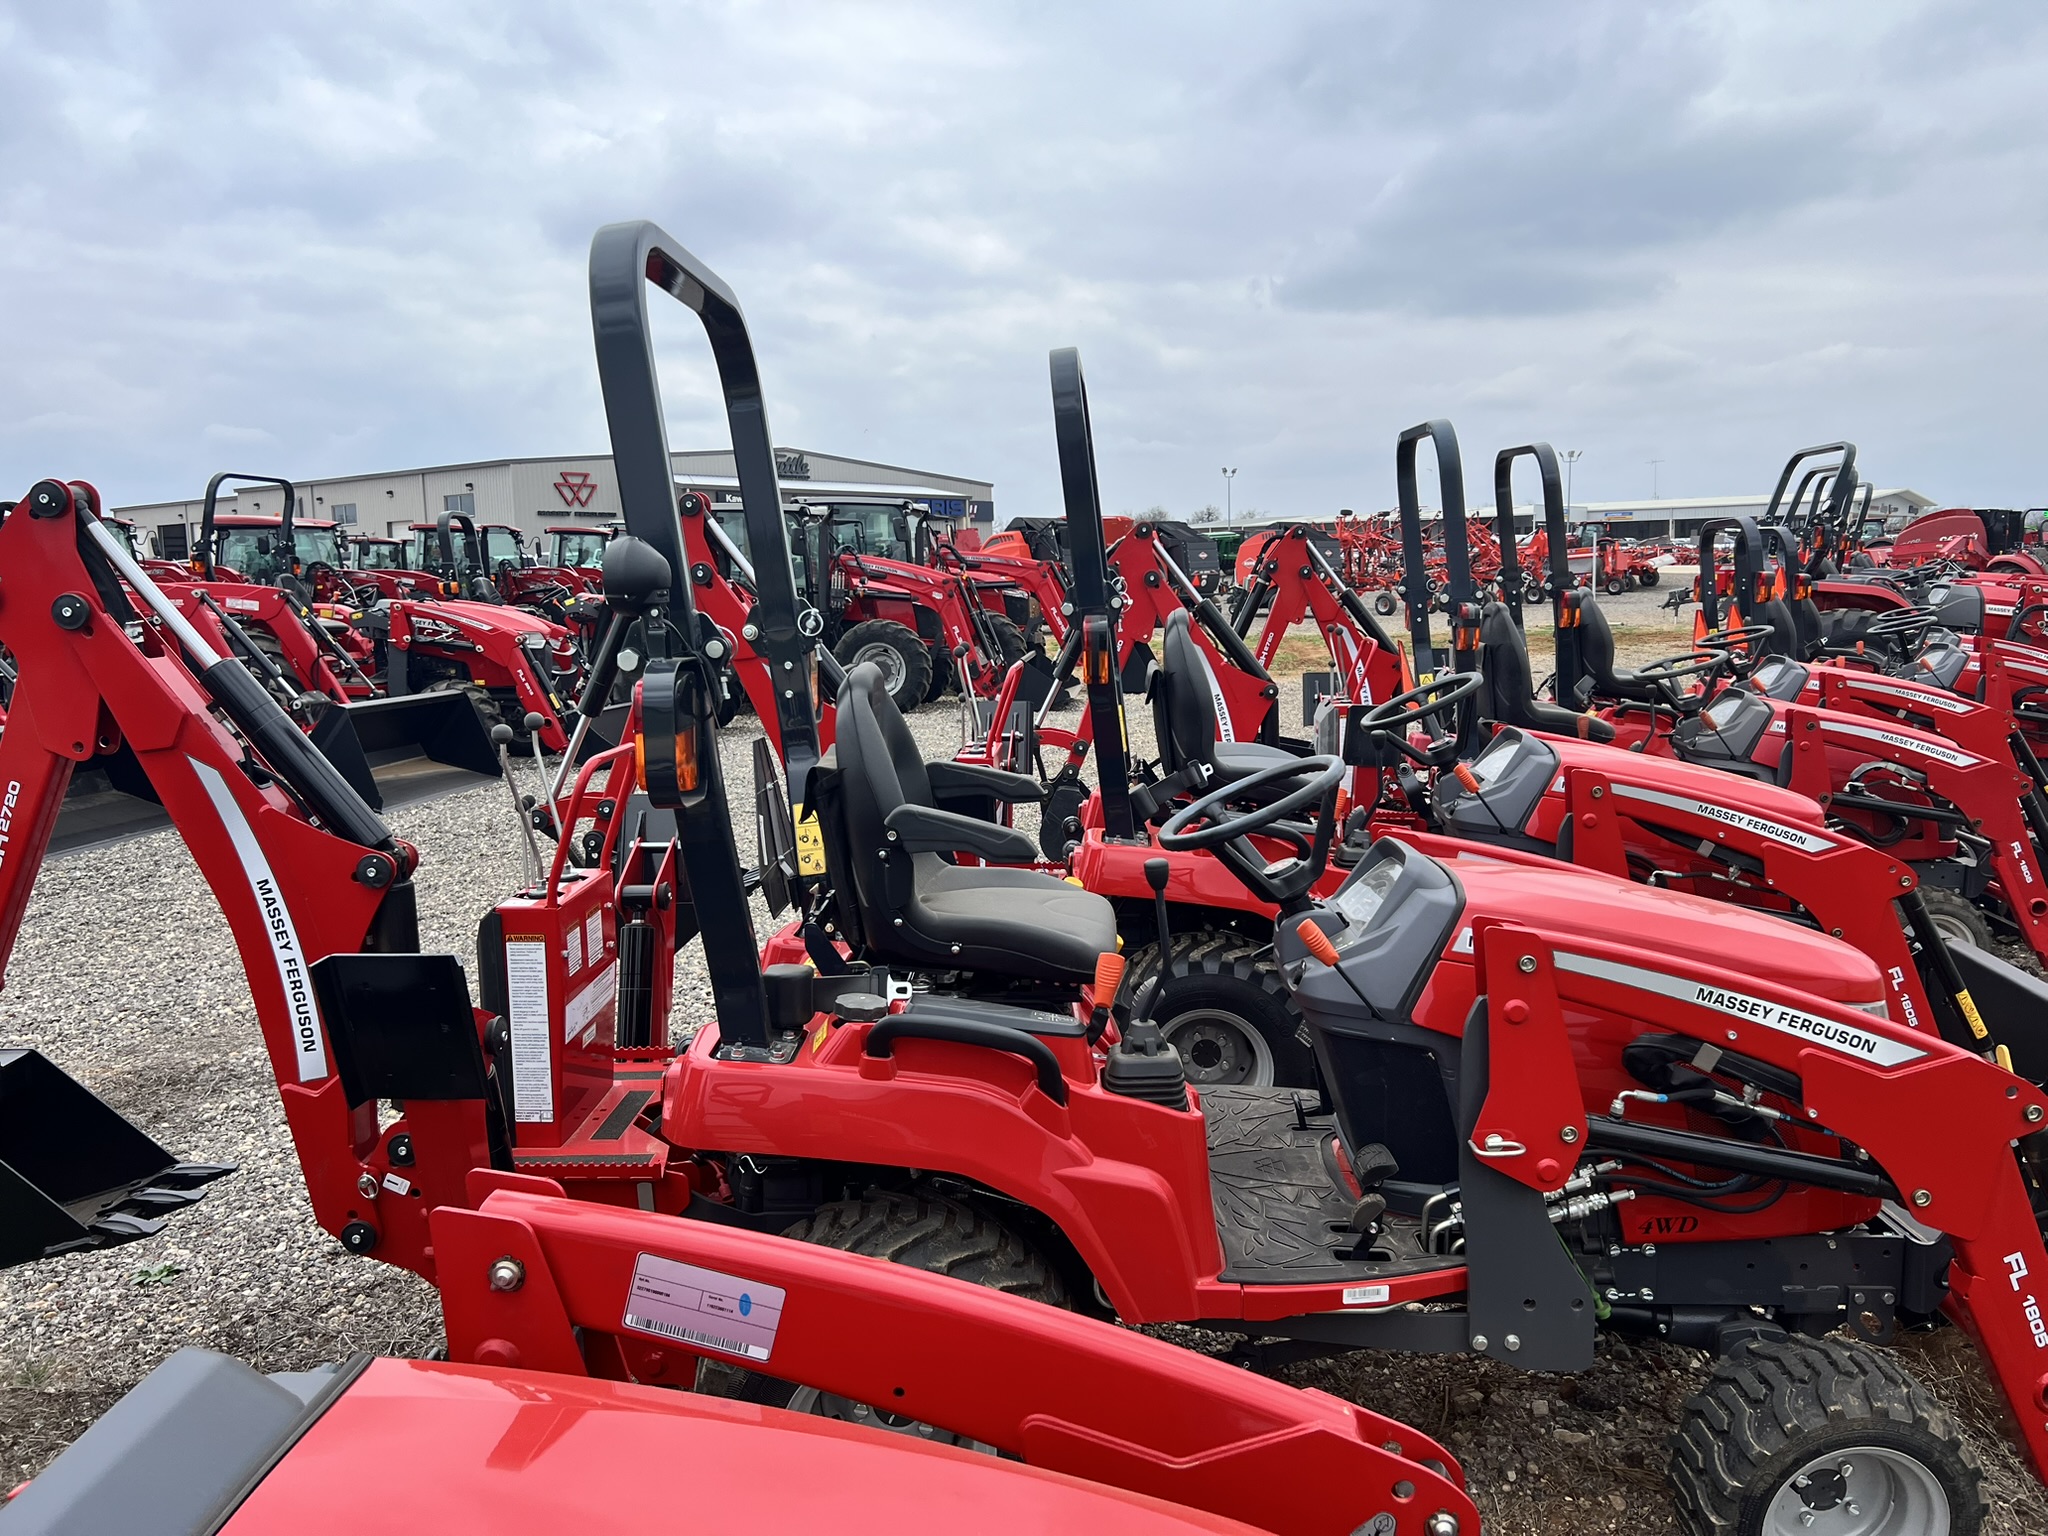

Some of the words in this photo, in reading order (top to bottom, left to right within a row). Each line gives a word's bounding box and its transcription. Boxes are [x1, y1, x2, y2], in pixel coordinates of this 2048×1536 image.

[1214, 693, 1229, 726] MASSEY
[1894, 689, 1922, 699] MASSEY
[1923, 695, 1958, 709] FERGUSON
[1880, 733, 1915, 747] MASSEY
[1915, 743, 1958, 761] FERGUSON
[0, 780, 21, 833] 2720
[1697, 804, 1745, 824] MASSEY
[1746, 818, 1807, 845] FERGUSON
[2010, 841, 2022, 858] FL
[256, 878, 293, 951] MASSEY
[283, 957, 317, 1053] FERGUSON
[1887, 966, 1904, 991] FL
[1900, 993, 1918, 1027] 1805
[1696, 987, 1774, 1020] MASSEY
[1777, 1011, 1877, 1054] FERGUSON
[1638, 1216, 1699, 1235] 4WD
[2002, 1251, 2029, 1292] FL
[2022, 1294, 2048, 1348] 1805
